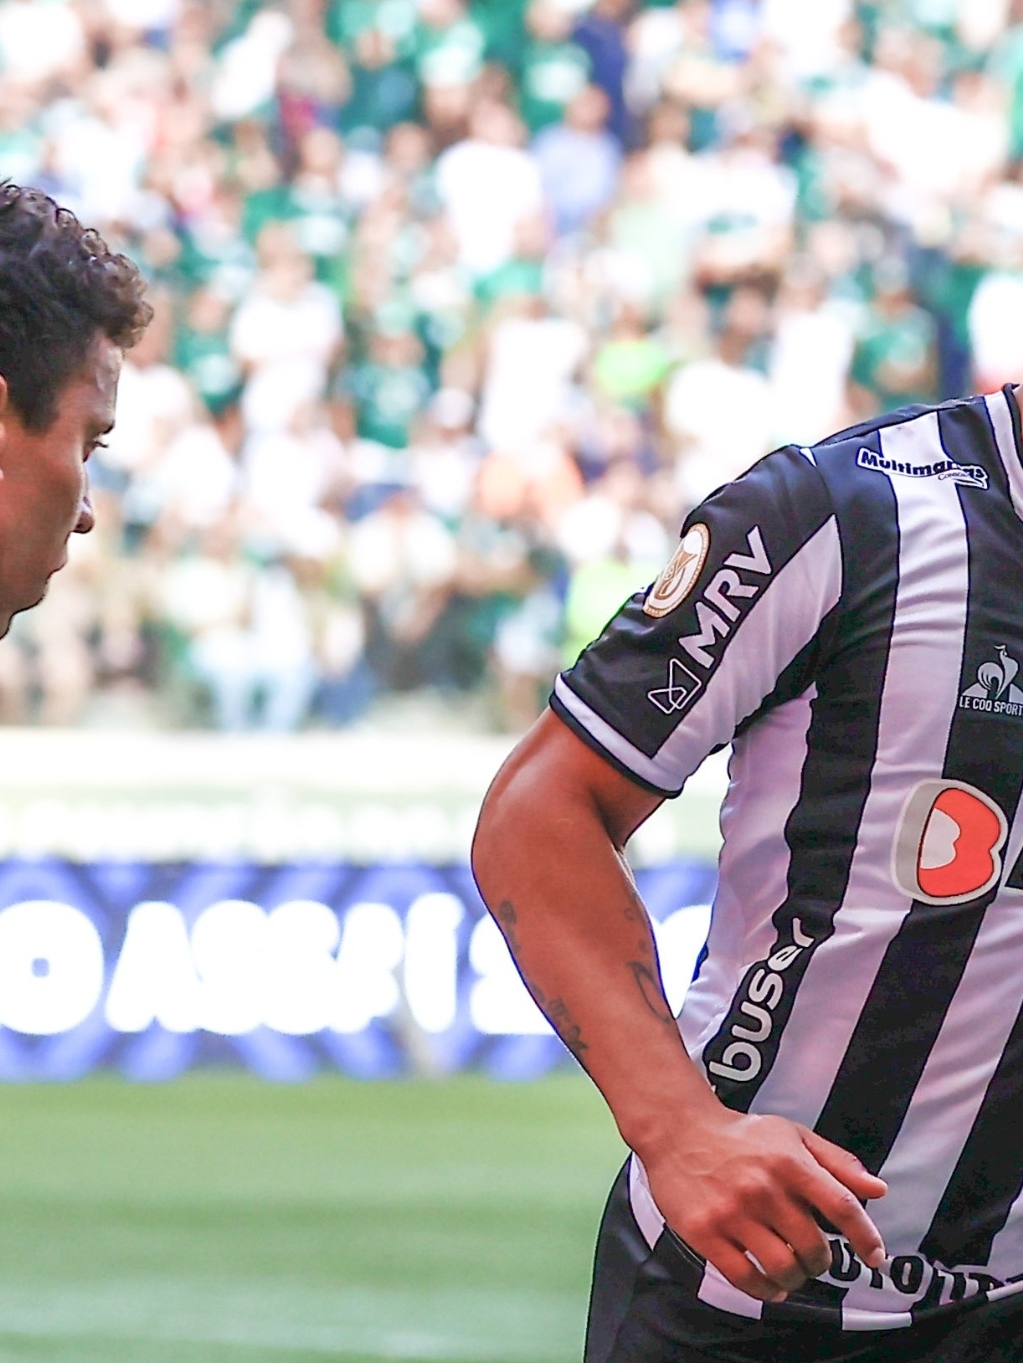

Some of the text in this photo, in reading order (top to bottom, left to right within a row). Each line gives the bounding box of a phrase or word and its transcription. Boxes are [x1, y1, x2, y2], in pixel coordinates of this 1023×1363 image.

[860, 450, 985, 478] Multimaras
[679, 525, 773, 669] MRV
[959, 696, 972, 709] LE
[972, 698, 992, 712] COQ
[709, 917, 815, 1082] buser
